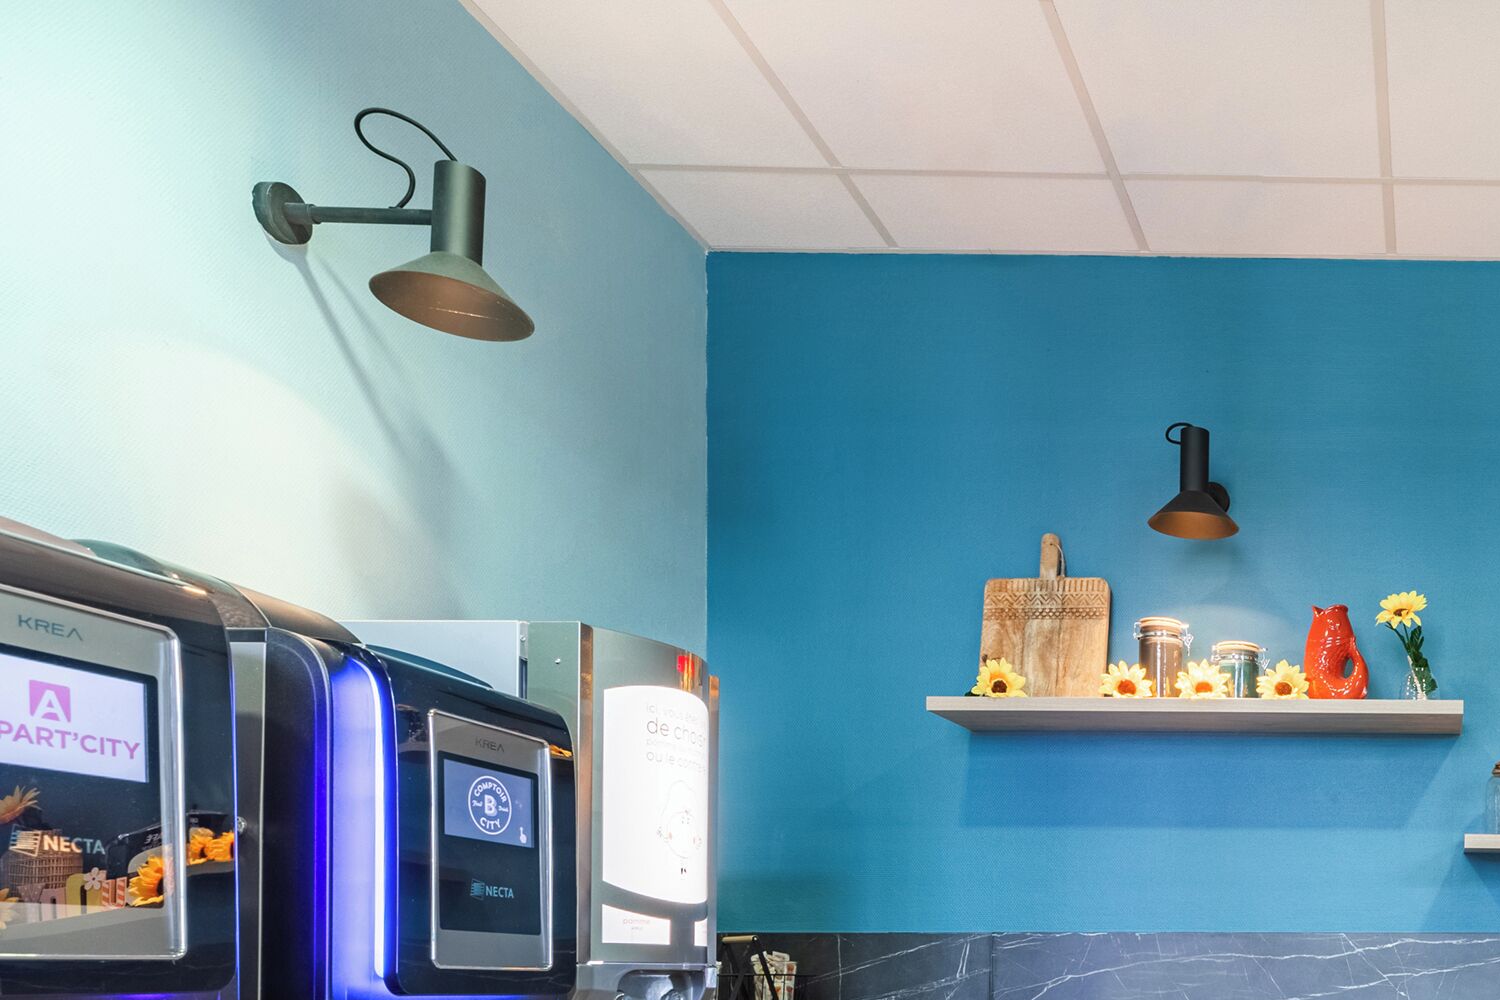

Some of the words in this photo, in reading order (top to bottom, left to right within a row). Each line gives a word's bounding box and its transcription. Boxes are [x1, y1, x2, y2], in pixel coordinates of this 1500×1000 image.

[18, 614, 84, 641] KREA
[646, 716, 670, 737] de
[475, 737, 504, 752] KREA
[474, 782, 507, 803] COMPTOIR
[484, 794, 498, 817] B
[480, 816, 501, 830] CITY
[43, 834, 106, 856] NECTA
[485, 885, 514, 899] NECTA
